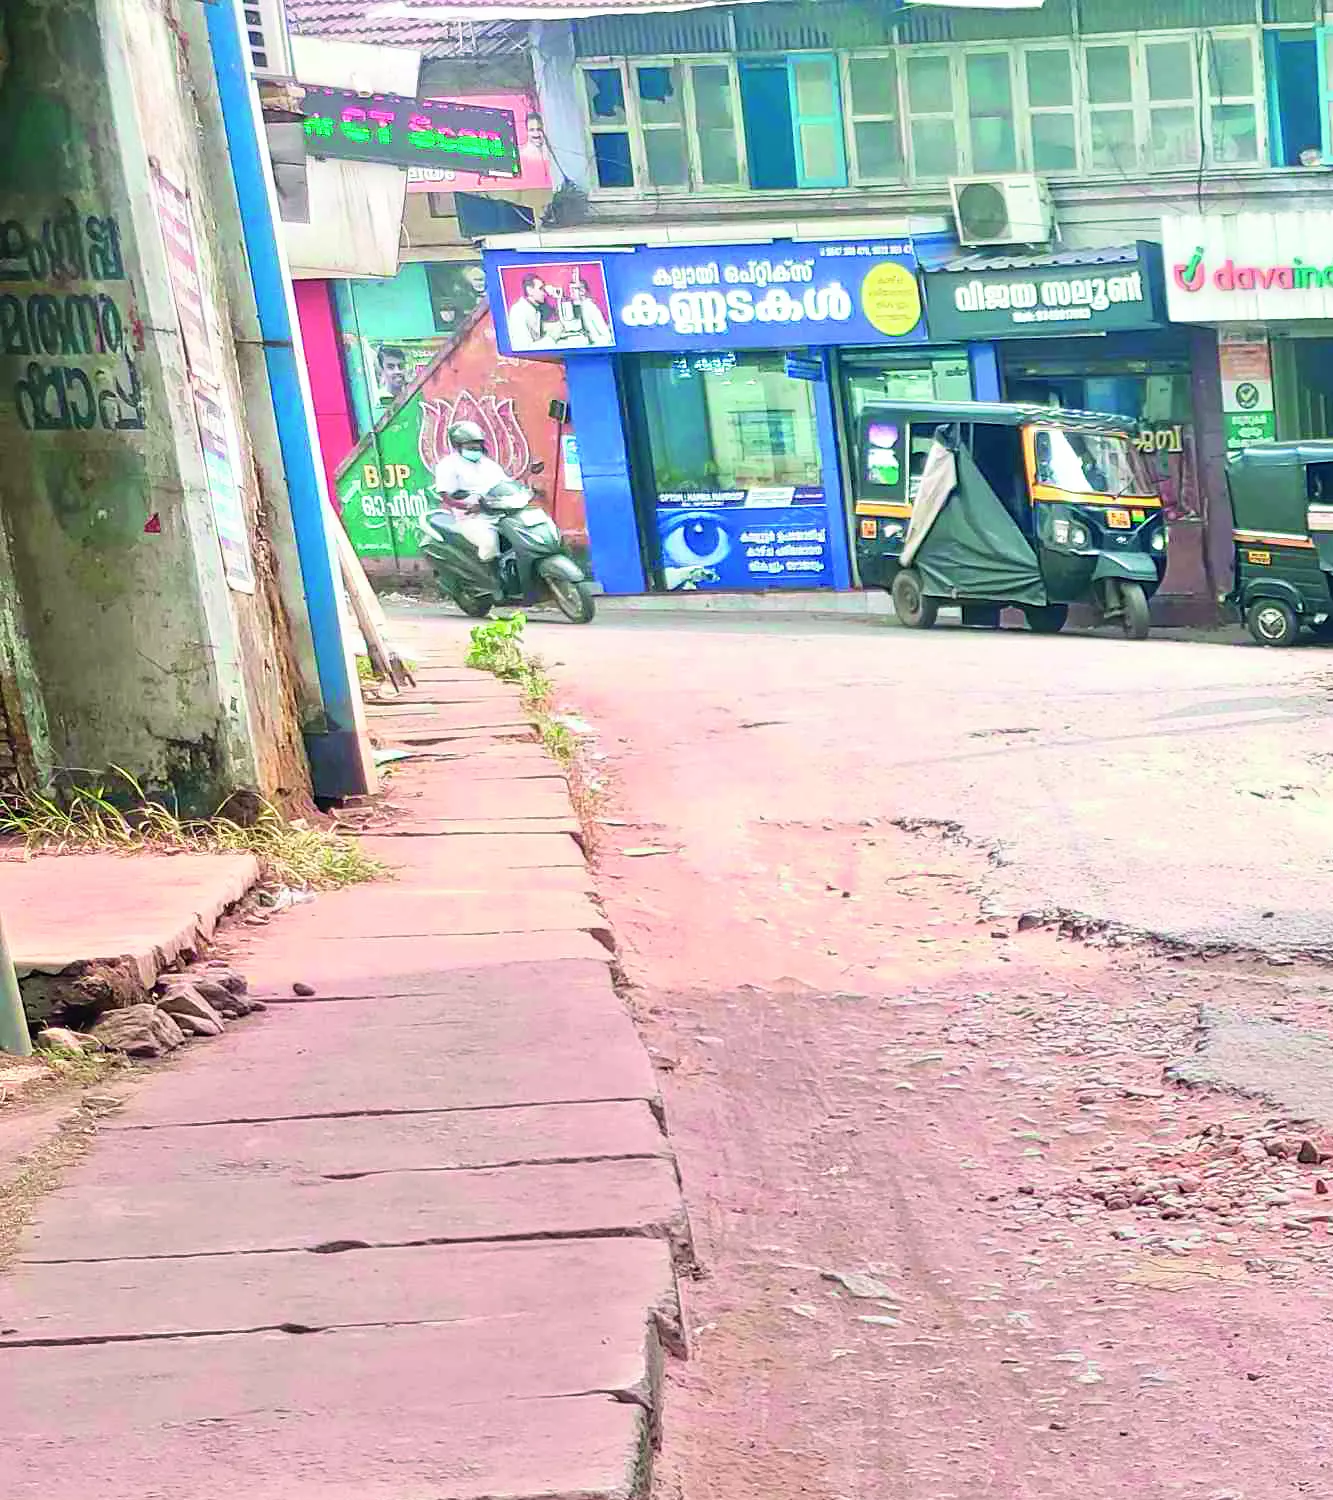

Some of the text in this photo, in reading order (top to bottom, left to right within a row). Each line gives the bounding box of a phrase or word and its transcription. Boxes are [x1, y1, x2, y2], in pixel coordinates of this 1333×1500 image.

[621, 279, 853, 335] കണ്ണടകൾ
[955, 279, 1038, 312] വിജയ
[363, 463, 411, 489] BJP
